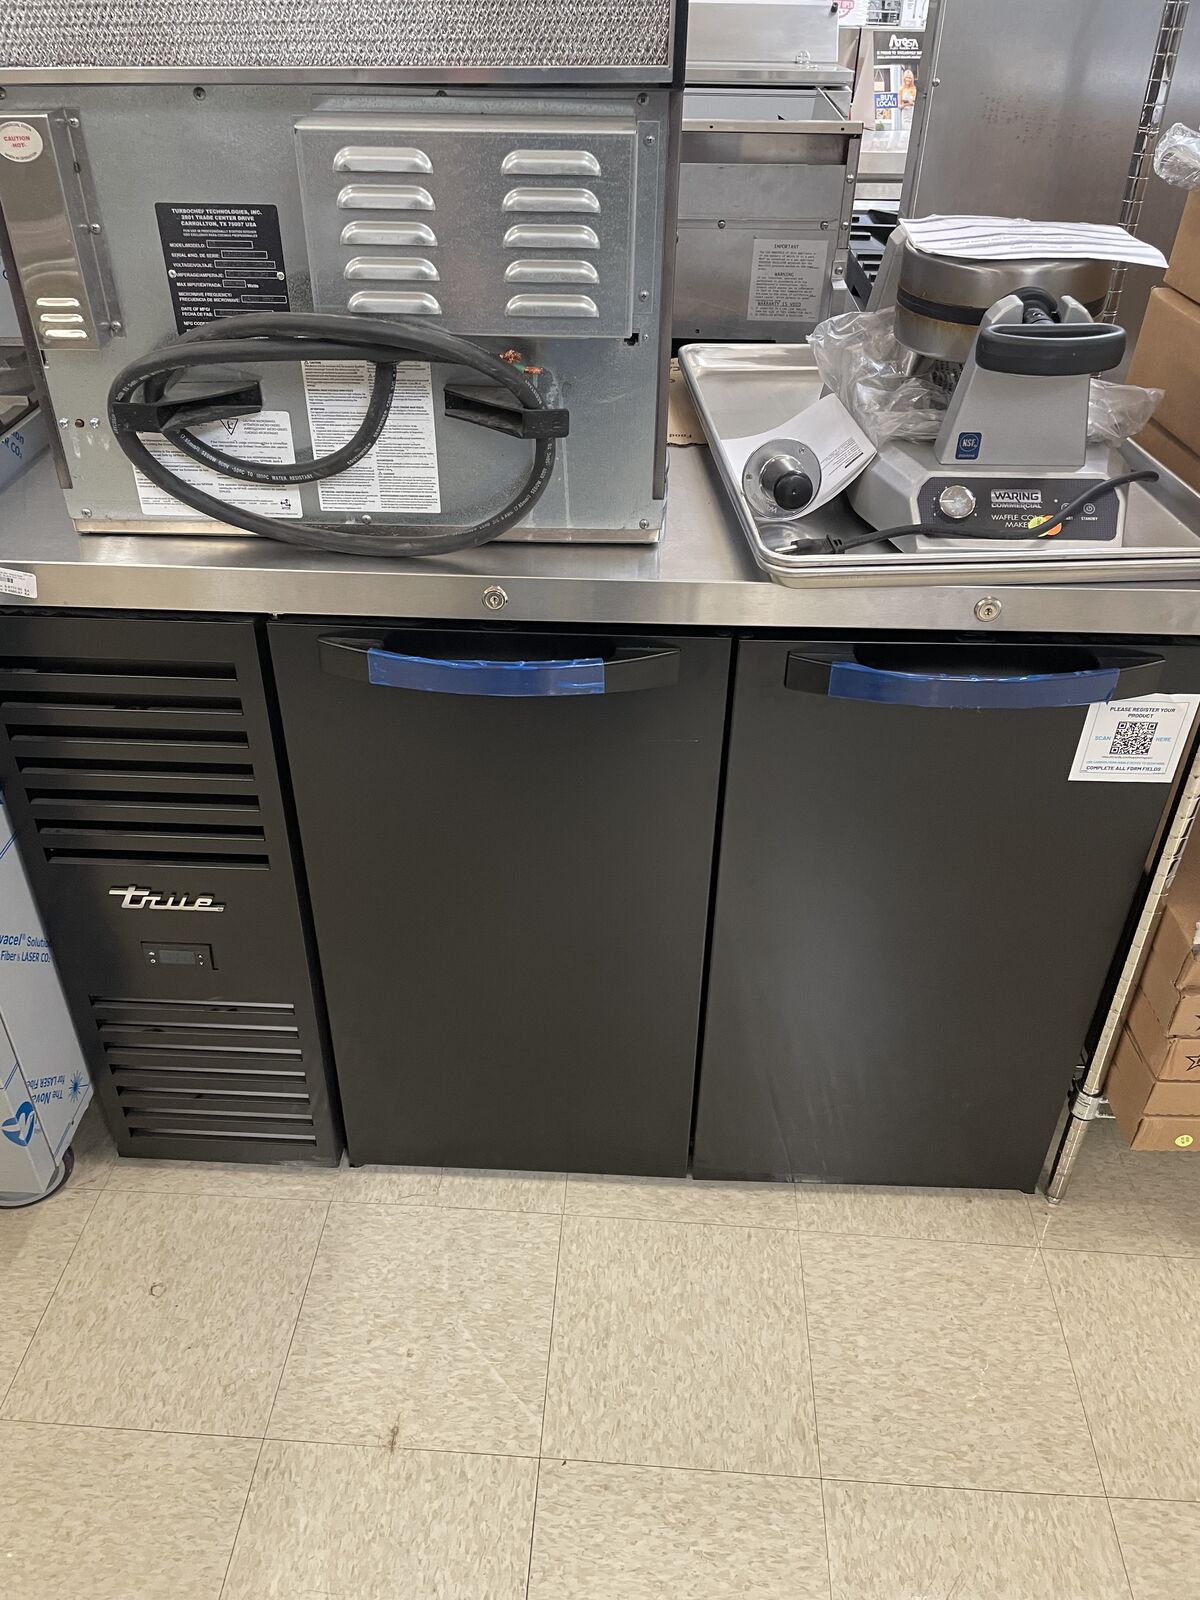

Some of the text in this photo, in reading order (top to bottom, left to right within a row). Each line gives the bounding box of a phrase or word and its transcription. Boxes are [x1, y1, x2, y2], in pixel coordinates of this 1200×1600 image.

[962, 438, 976, 447] NSF
[993, 492, 1039, 502] WARING
[108, 886, 225, 912] true
[21, 952, 40, 962] LASER
[40, 1076, 57, 1088] LASER
[52, 1090, 63, 1100] The
